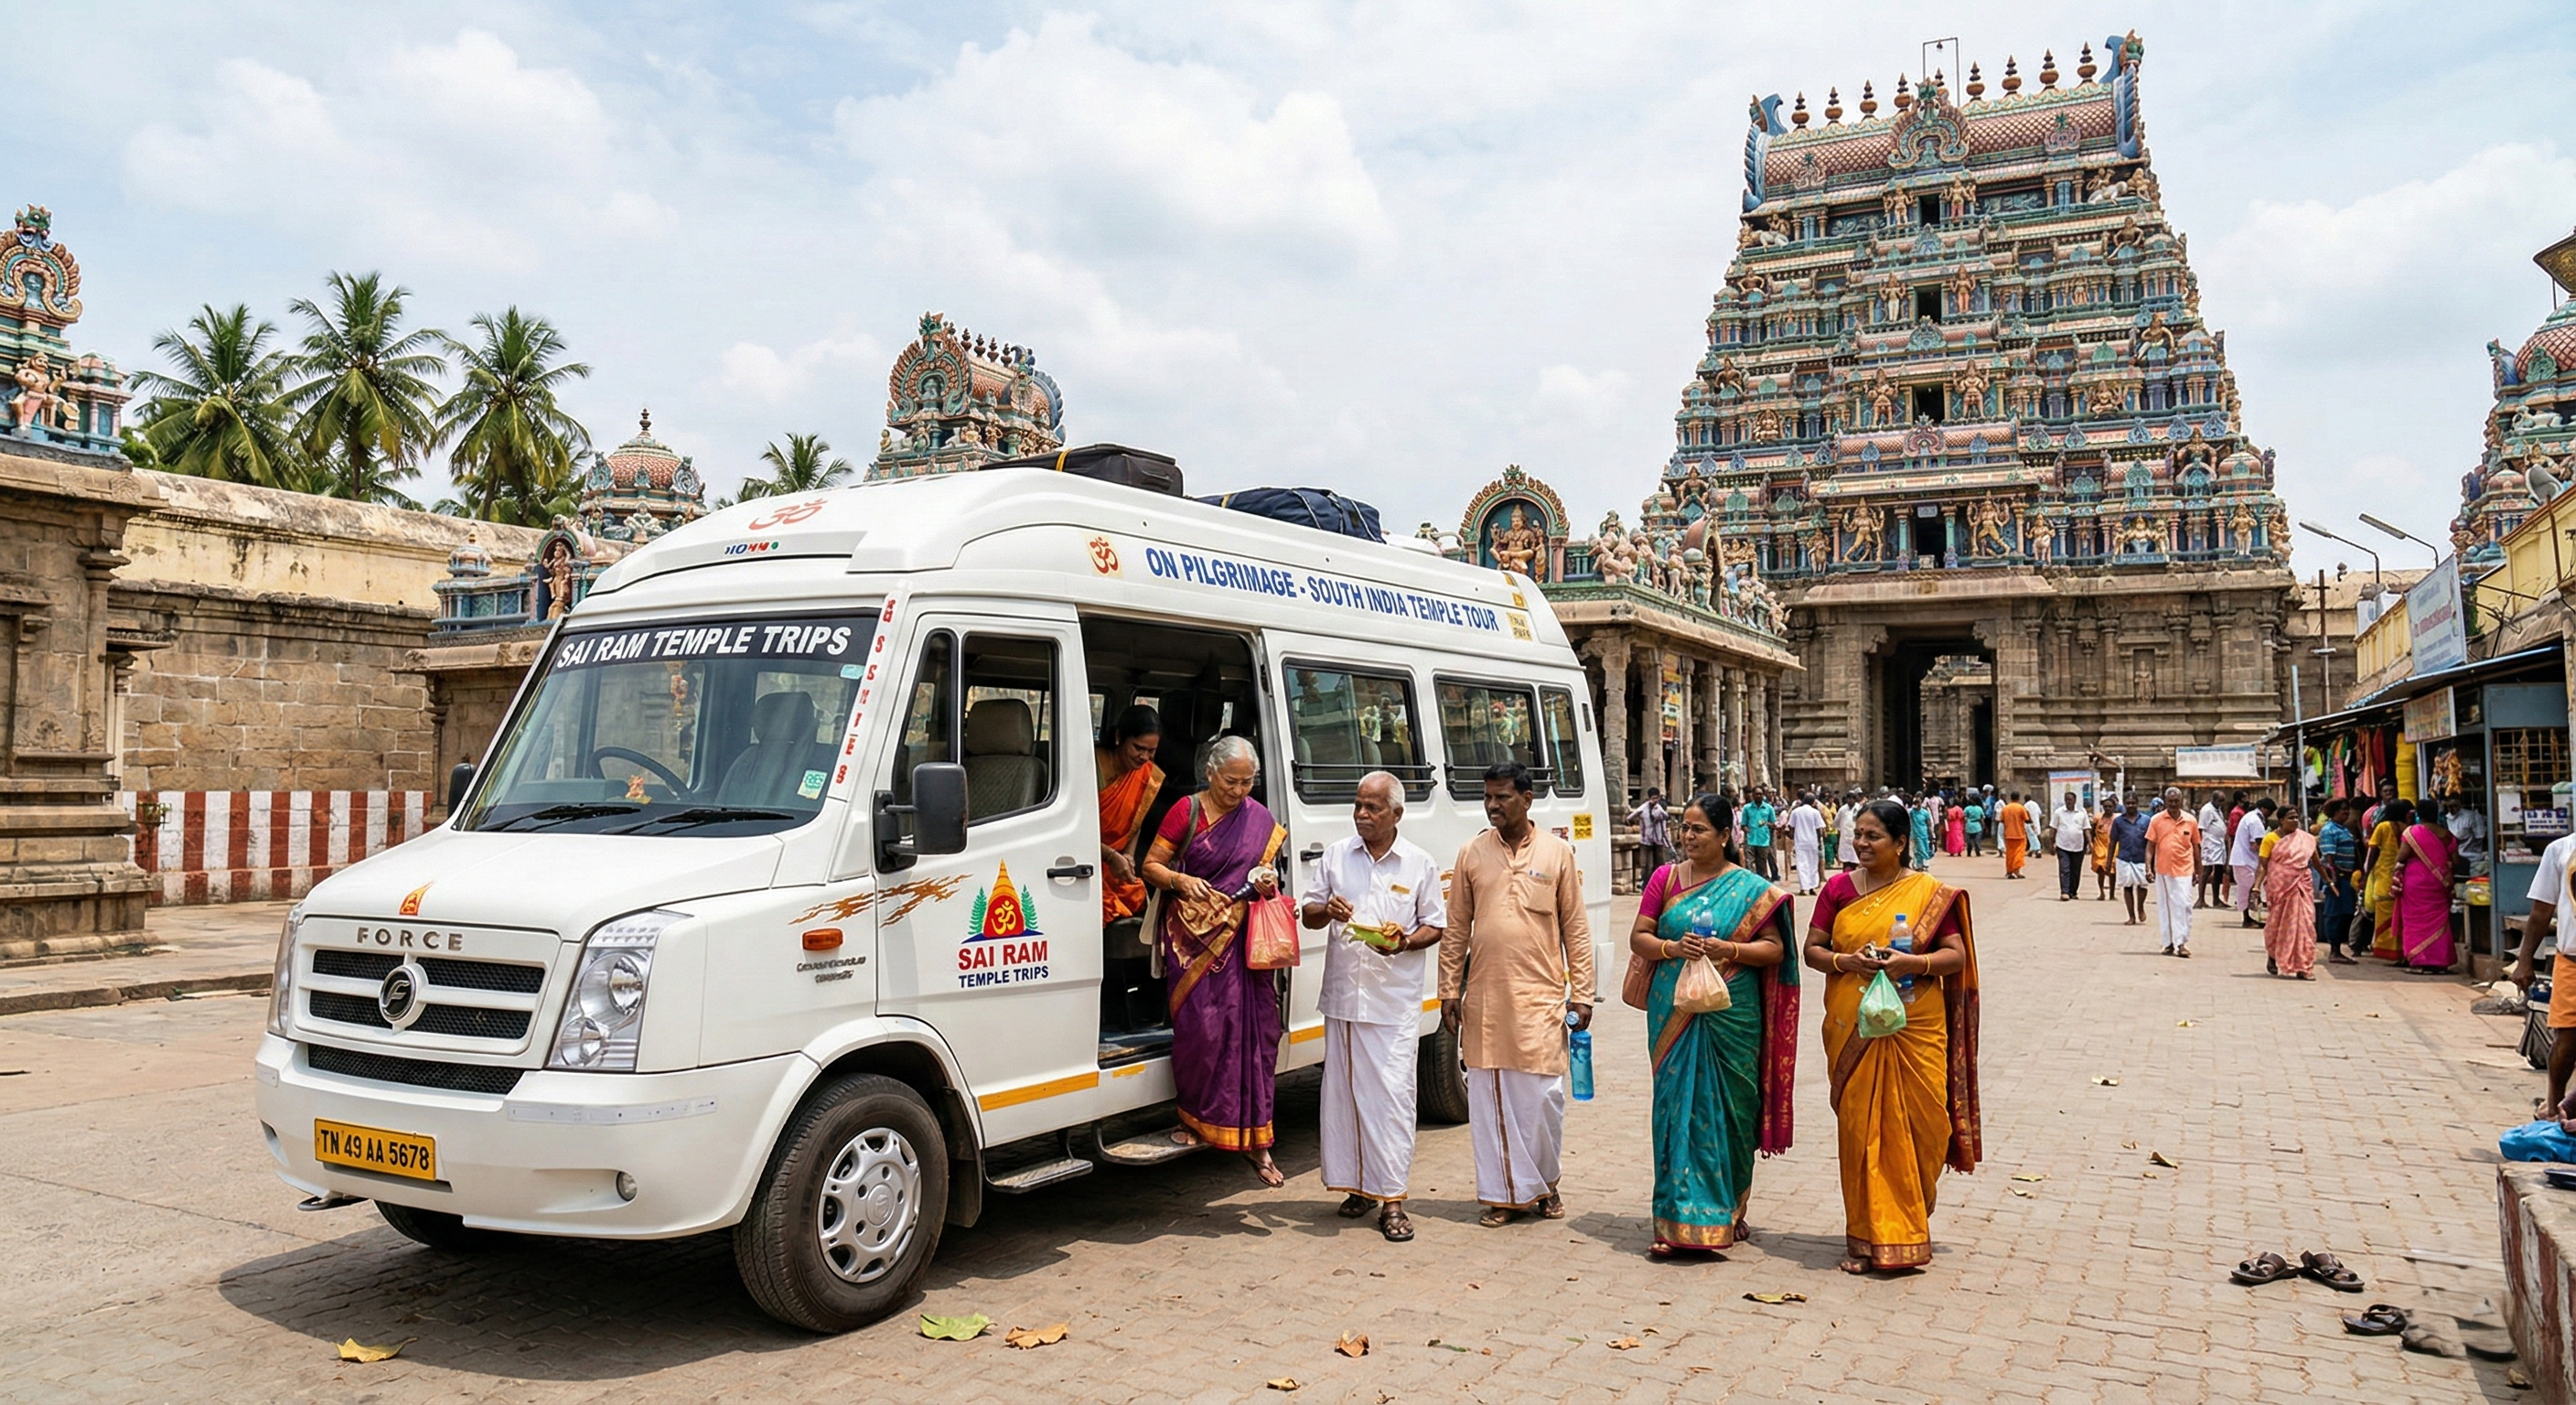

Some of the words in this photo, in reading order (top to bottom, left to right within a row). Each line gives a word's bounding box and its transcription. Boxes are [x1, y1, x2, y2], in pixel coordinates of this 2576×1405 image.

[1145, 547, 1179, 579] ON
[1179, 553, 1297, 598] PILGRIMAGE
[1306, 575, 1365, 609] SOUTH
[1364, 586, 1410, 617] INDIA
[1407, 595, 1464, 626] TEMPLE
[1462, 605, 1499, 632] TOUR
[556, 638, 596, 669] SAI
[593, 632, 649, 662] RAM
[650, 626, 757, 657] TEMPLE
[761, 626, 852, 656] TRIPS
[357, 927, 463, 951] FORCE
[958, 946, 994, 971] SAI
[1003, 940, 1047, 966] RAM
[958, 970, 1010, 988] TEMPLE
[1013, 966, 1049, 981] TRIPS
[320, 1129, 339, 1155] TN
[344, 1134, 362, 1159] 49
[366, 1137, 384, 1164] AA
[389, 1142, 429, 1171] 5678
